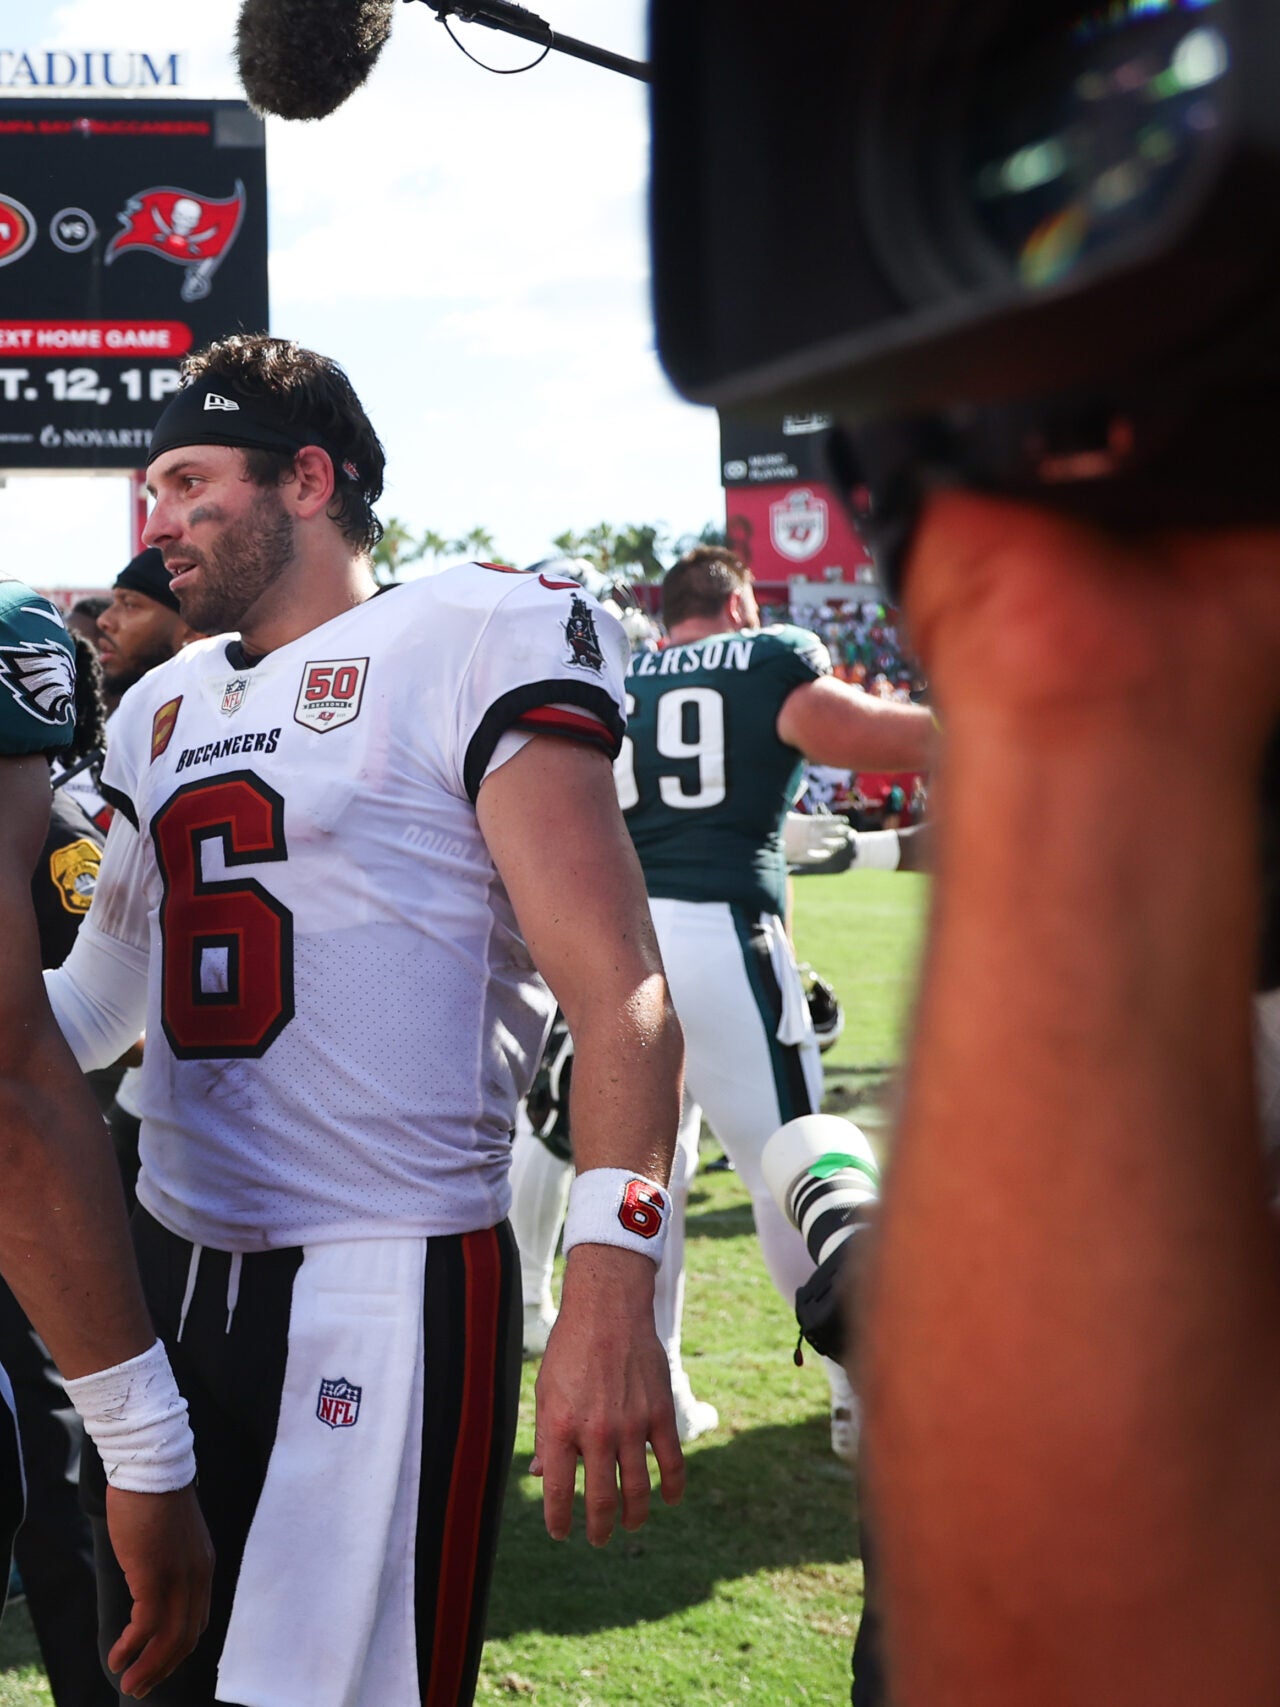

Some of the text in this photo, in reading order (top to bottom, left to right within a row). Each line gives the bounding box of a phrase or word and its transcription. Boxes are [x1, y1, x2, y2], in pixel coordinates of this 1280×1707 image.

[37, 329, 100, 349] HOME
[105, 329, 171, 350] GAME
[46, 367, 112, 405] 12,
[121, 368, 142, 401] 1
[149, 368, 183, 401] P
[63, 428, 153, 448] NOVARTI
[223, 692, 241, 709] NFL
[305, 666, 359, 701] 50
[176, 727, 282, 773] BUCCANEERS
[150, 770, 296, 1060] 6
[618, 1179, 665, 1239] 6
[320, 1396, 354, 1425] NFL
